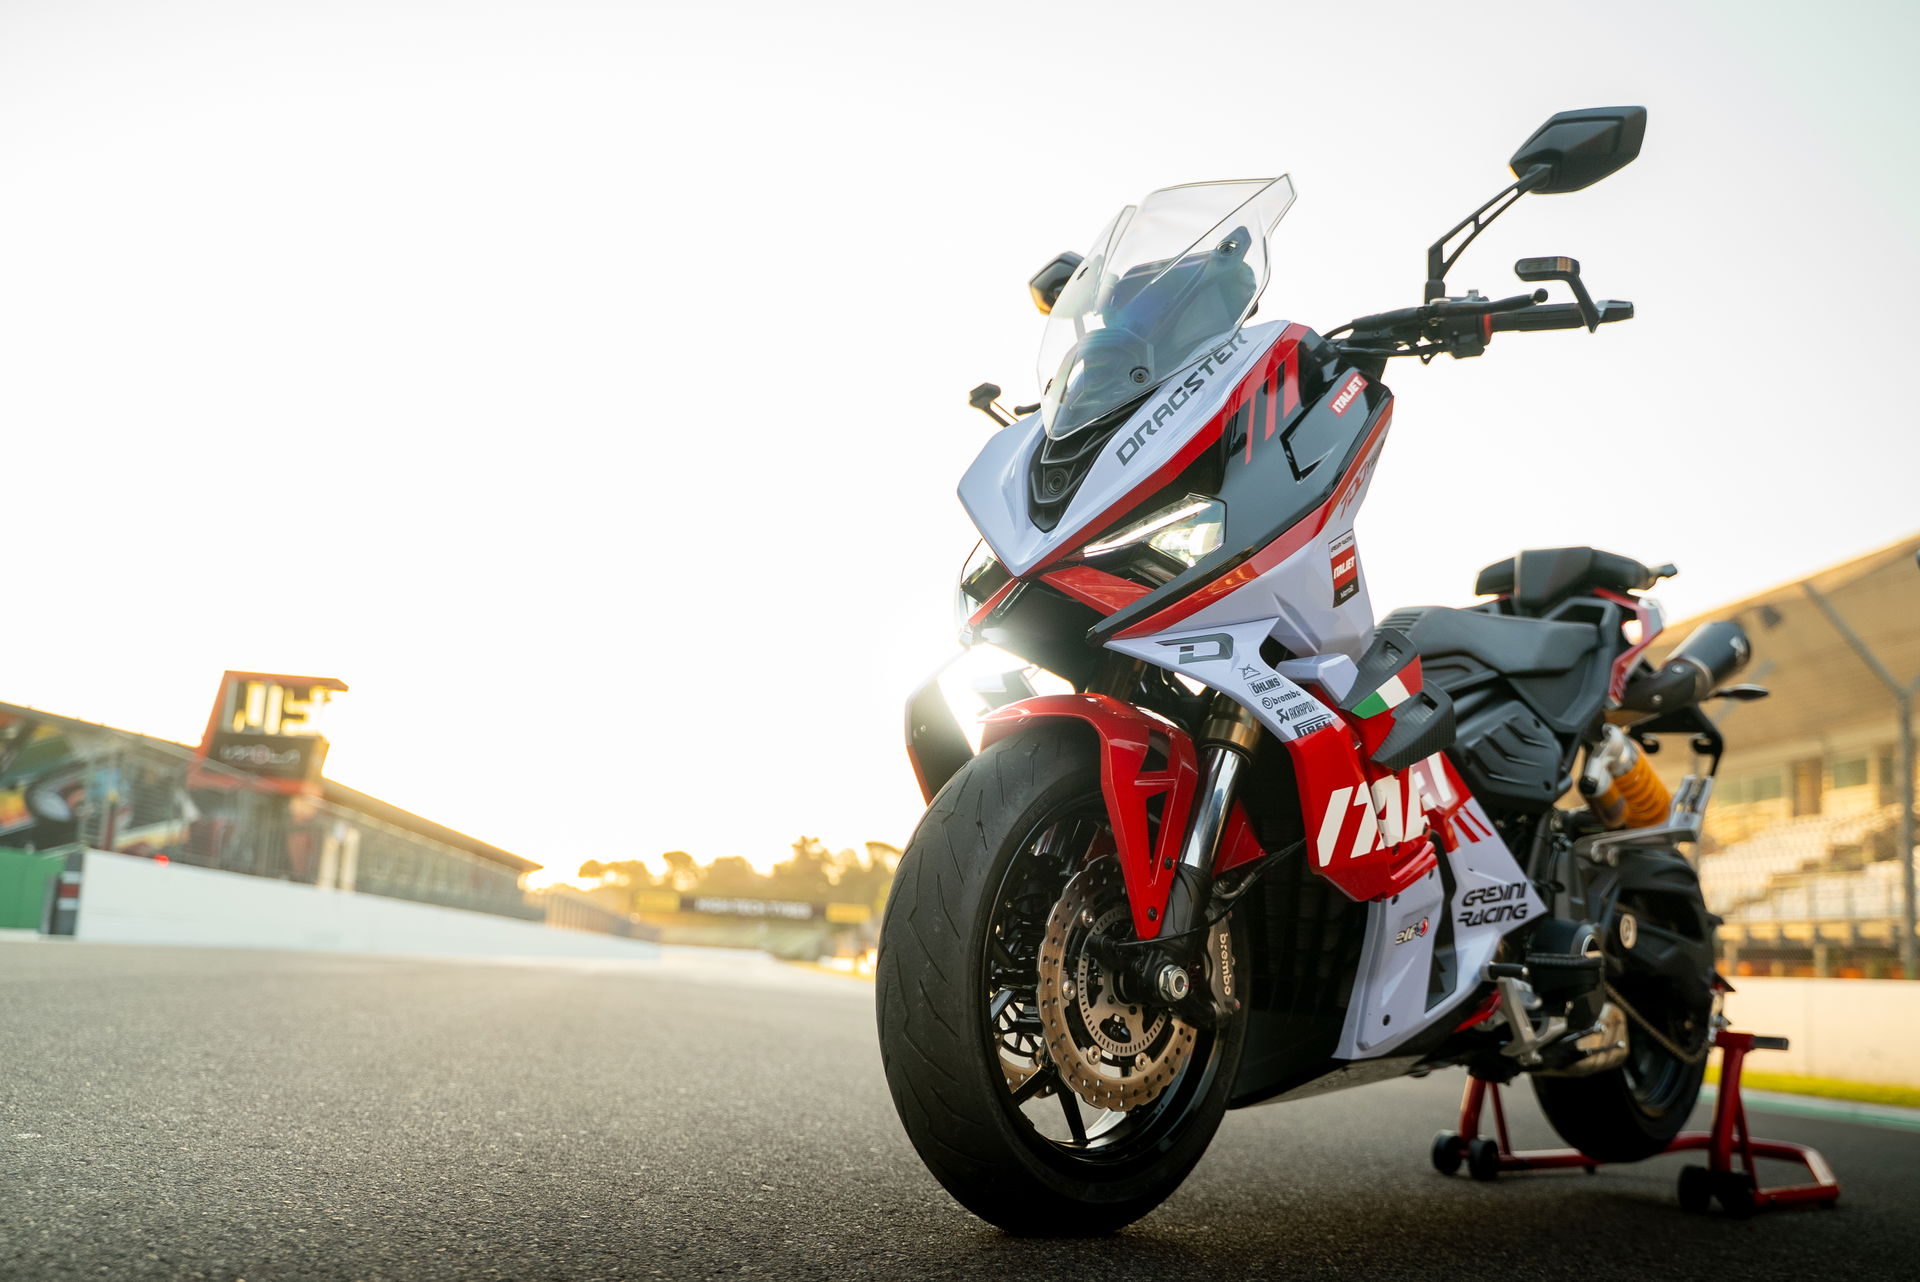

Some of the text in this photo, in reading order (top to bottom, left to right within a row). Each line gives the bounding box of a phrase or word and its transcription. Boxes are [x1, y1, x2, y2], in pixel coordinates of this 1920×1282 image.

[1116, 332, 1249, 466] DRAGSTER
[1332, 376, 1363, 413] ITALJET
[1252, 677, 1281, 694] ÖHLINS
[1458, 903, 1528, 927] RACING
[1219, 932, 1232, 996] brembo
